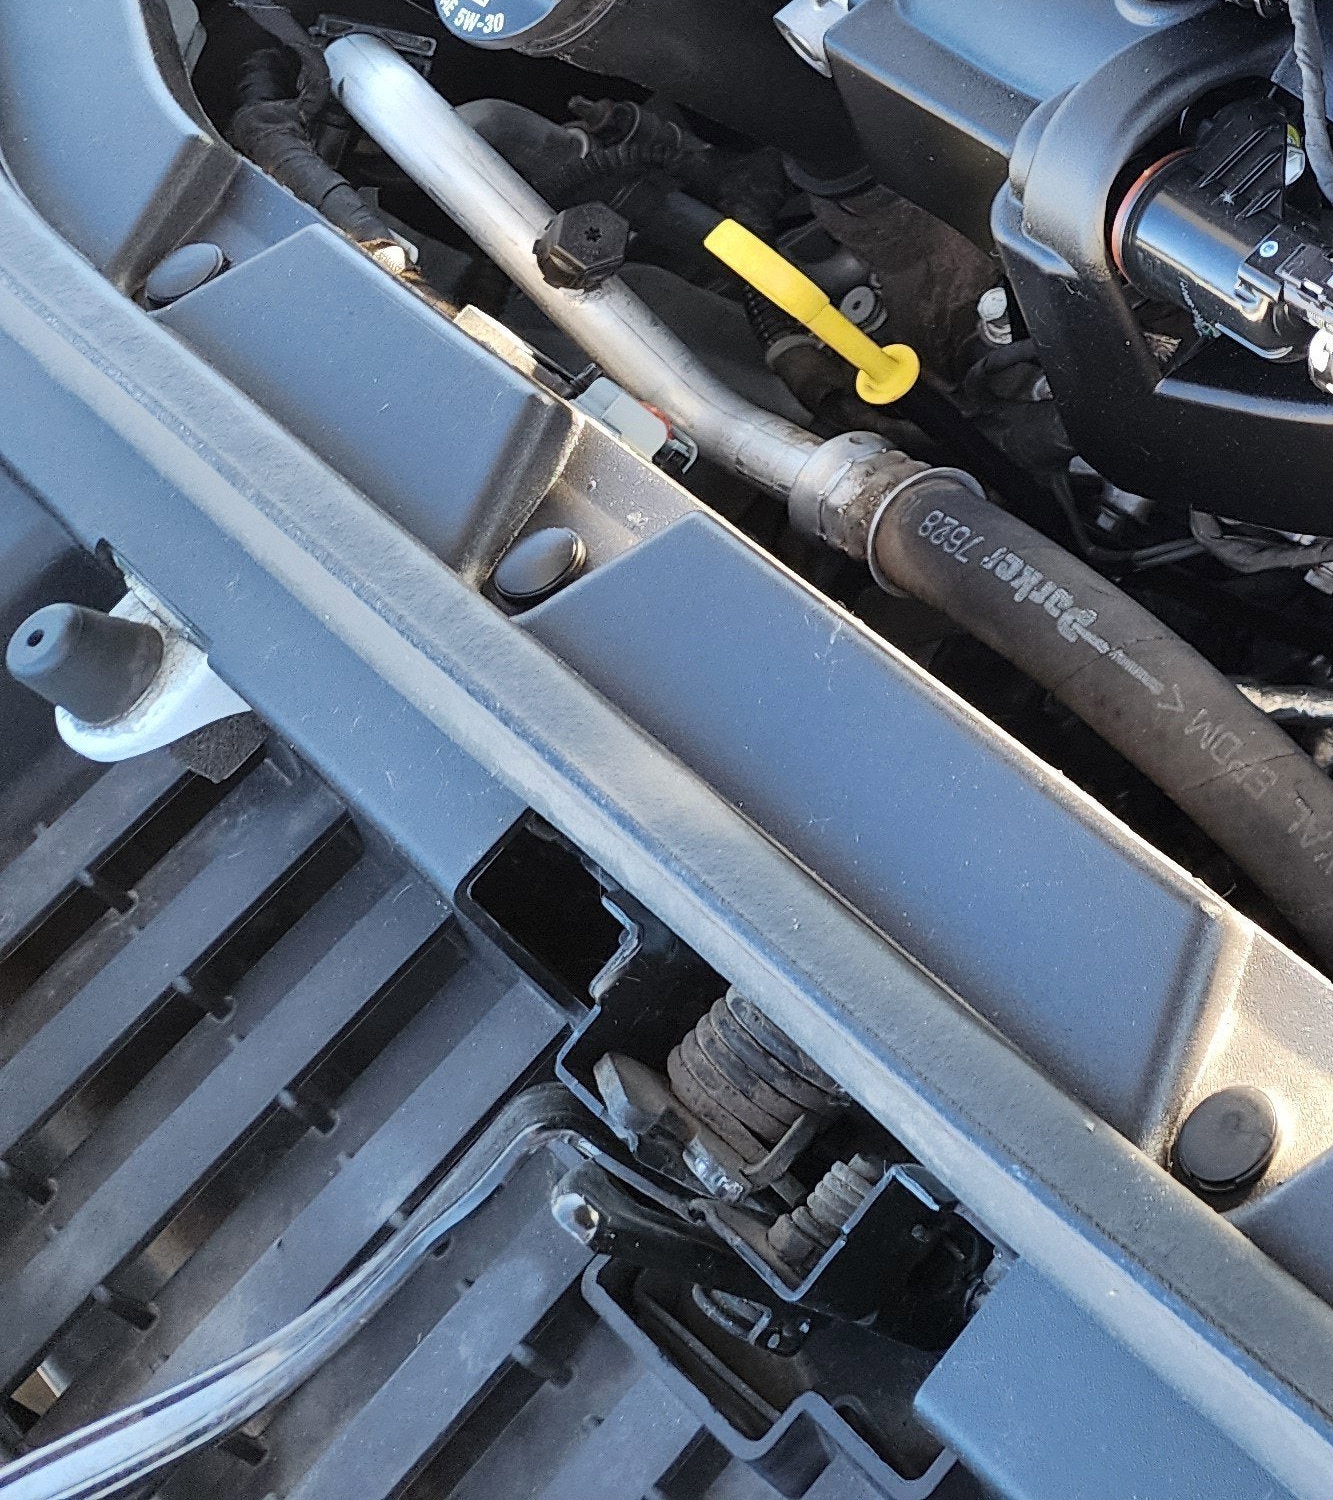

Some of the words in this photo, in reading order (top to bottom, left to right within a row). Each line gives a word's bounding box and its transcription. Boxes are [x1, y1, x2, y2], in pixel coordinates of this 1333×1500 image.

[454, 8, 504, 33] 5W-30
[916, 507, 984, 563] 7628
[977, 544, 1099, 643] Parker
